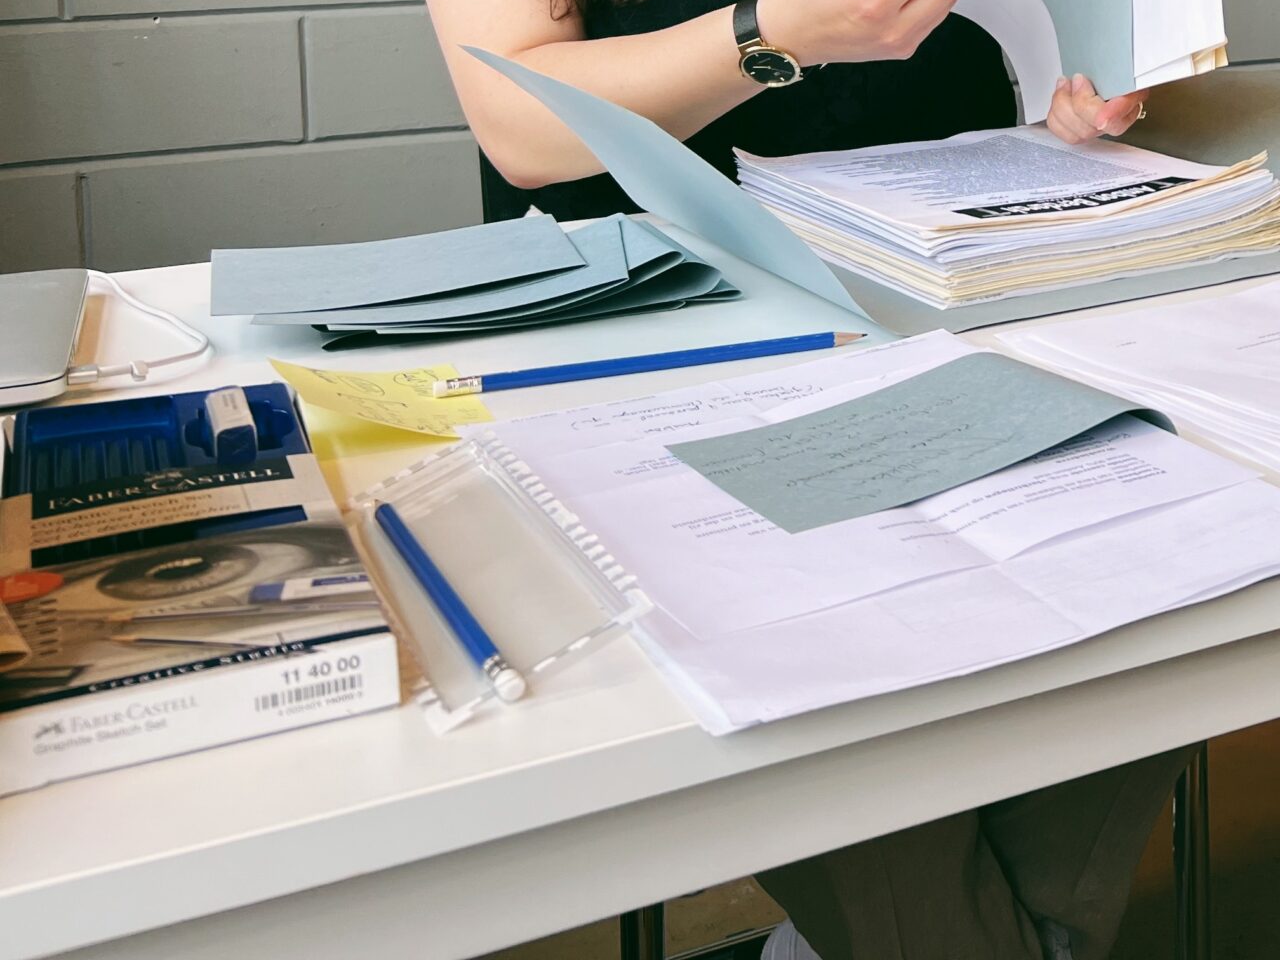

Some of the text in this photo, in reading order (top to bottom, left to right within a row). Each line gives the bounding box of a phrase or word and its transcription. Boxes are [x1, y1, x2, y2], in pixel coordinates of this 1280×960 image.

[281, 654, 361, 685] 11 40 00
